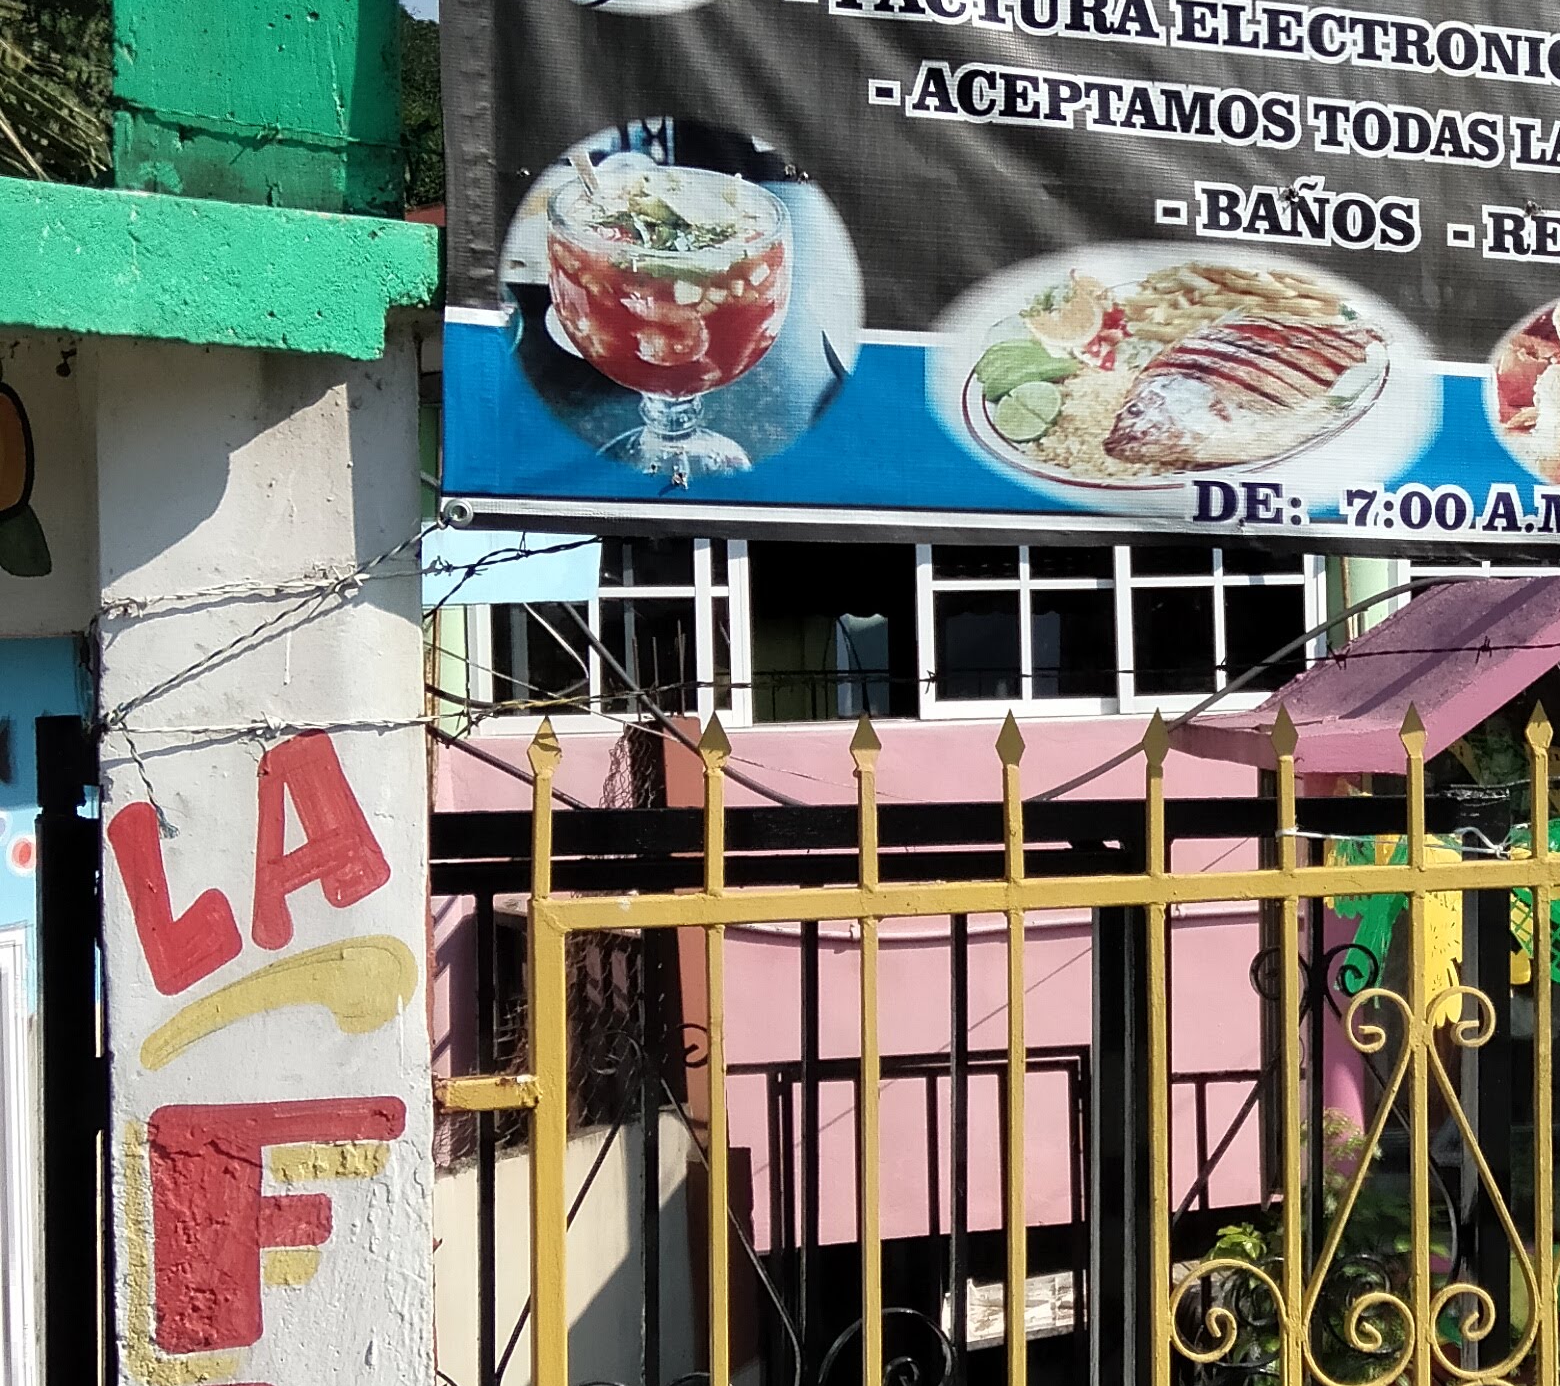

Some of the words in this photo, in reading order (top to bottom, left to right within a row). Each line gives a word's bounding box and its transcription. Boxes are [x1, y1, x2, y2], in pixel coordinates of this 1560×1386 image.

[1314, 104, 1499, 164] TODAS
[1193, 480, 1302, 527] DE:
[1346, 489, 1467, 531] 7:00
[108, 728, 392, 997] LA
